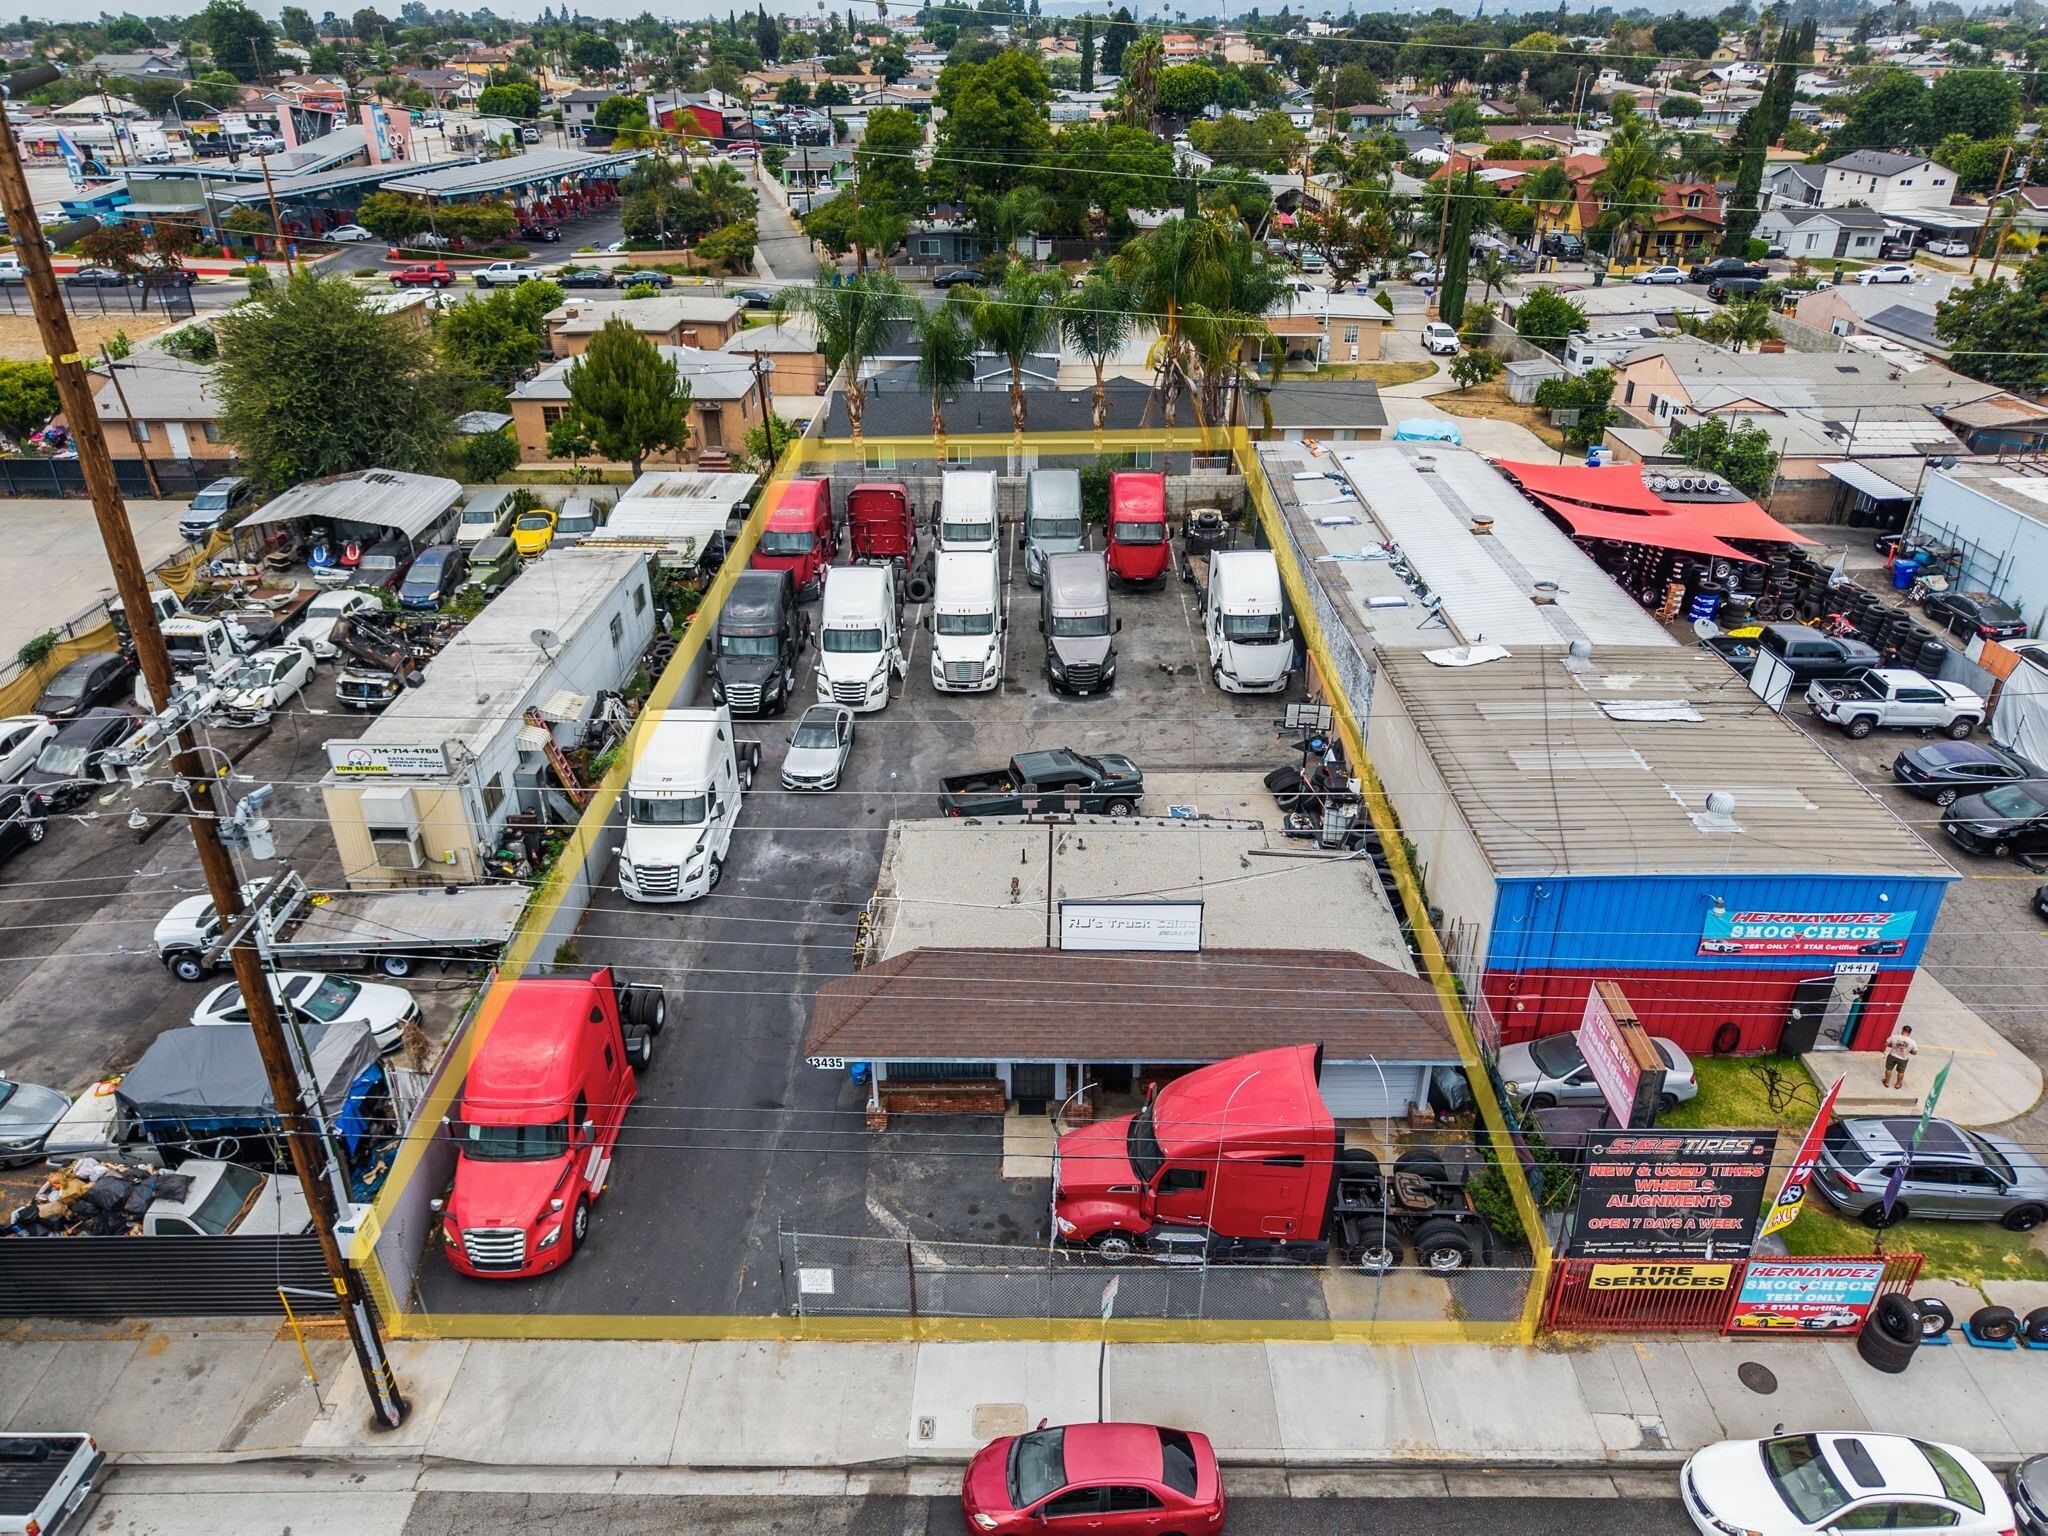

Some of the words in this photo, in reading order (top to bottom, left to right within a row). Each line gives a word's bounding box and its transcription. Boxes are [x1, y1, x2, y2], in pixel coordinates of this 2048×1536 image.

[1730, 912, 1895, 925] HERNANDEZ
[1108, 920, 1151, 929] Truck
[1730, 926, 1795, 938] SMOG
[1804, 926, 1881, 939] CHECK
[1869, 965, 1877, 974] A
[807, 1058, 843, 1068] 13435
[1683, 1138, 1755, 1154] TIRES
[1589, 1163, 1634, 1177] NEW
[1636, 1164, 1650, 1176] &
[1654, 1164, 1706, 1176] USED
[1711, 1164, 1765, 1177] TIRES
[1635, 1179, 1715, 1192] WHEELS
[1606, 1194, 1733, 1208] ALIGNMENTS
[1588, 1218, 1632, 1229] OPEN
[1632, 1218, 1641, 1229] 7
[1643, 1218, 1683, 1229] DAYS
[1684, 1218, 1697, 1229] A
[1699, 1218, 1744, 1229] WEEK
[1632, 1266, 1694, 1276] TIRE
[1750, 1266, 1879, 1278] HERNANDEZ
[1594, 1276, 1725, 1287] SERVICES
[1745, 1280, 1800, 1290] SMOG
[1808, 1280, 1875, 1291] CHECK
[1766, 1293, 1802, 1302] TEST
[1809, 1293, 1845, 1302] ONLY
[1802, 1304, 1849, 1312] Certified
